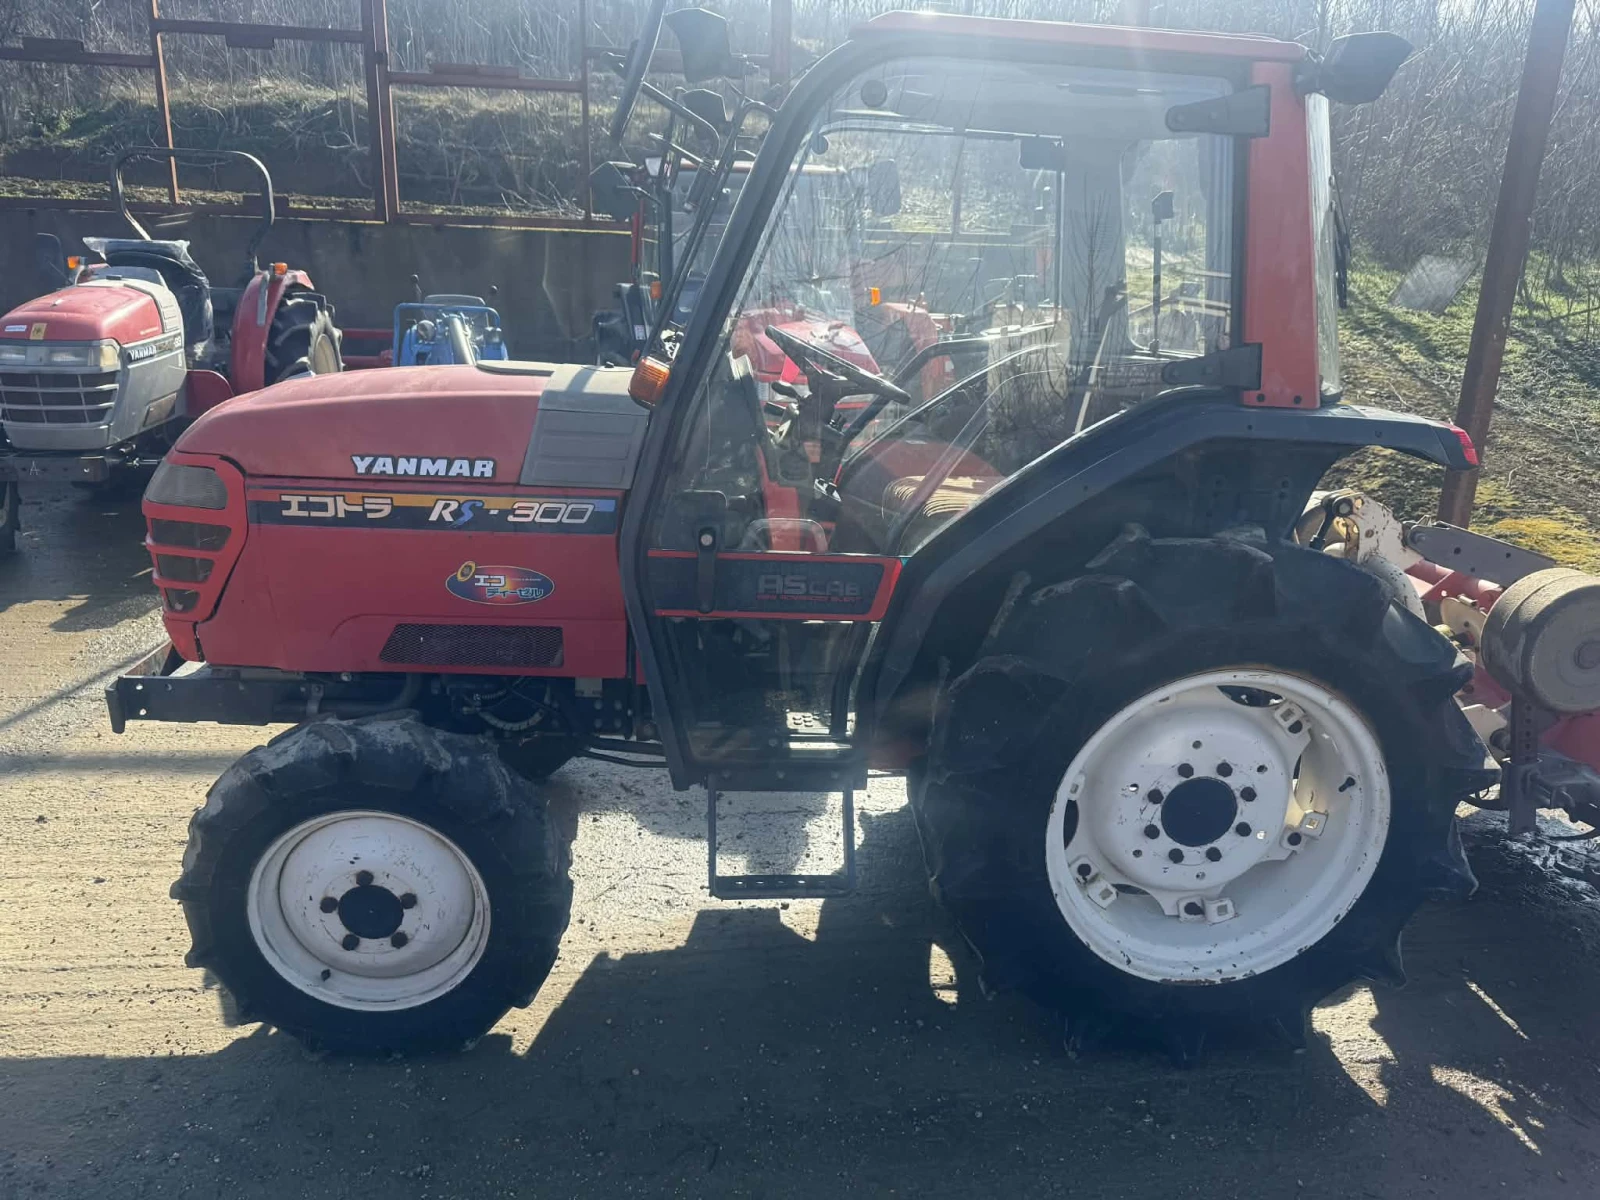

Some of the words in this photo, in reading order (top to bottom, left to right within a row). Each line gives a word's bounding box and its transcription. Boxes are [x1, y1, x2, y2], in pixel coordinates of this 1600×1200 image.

[129, 344, 157, 361] YANMAR
[351, 455, 496, 478] YANMAR
[280, 495, 393, 519] エコトラ
[474, 574, 506, 587] エコ
[486, 587, 544, 599] ディーゼル
